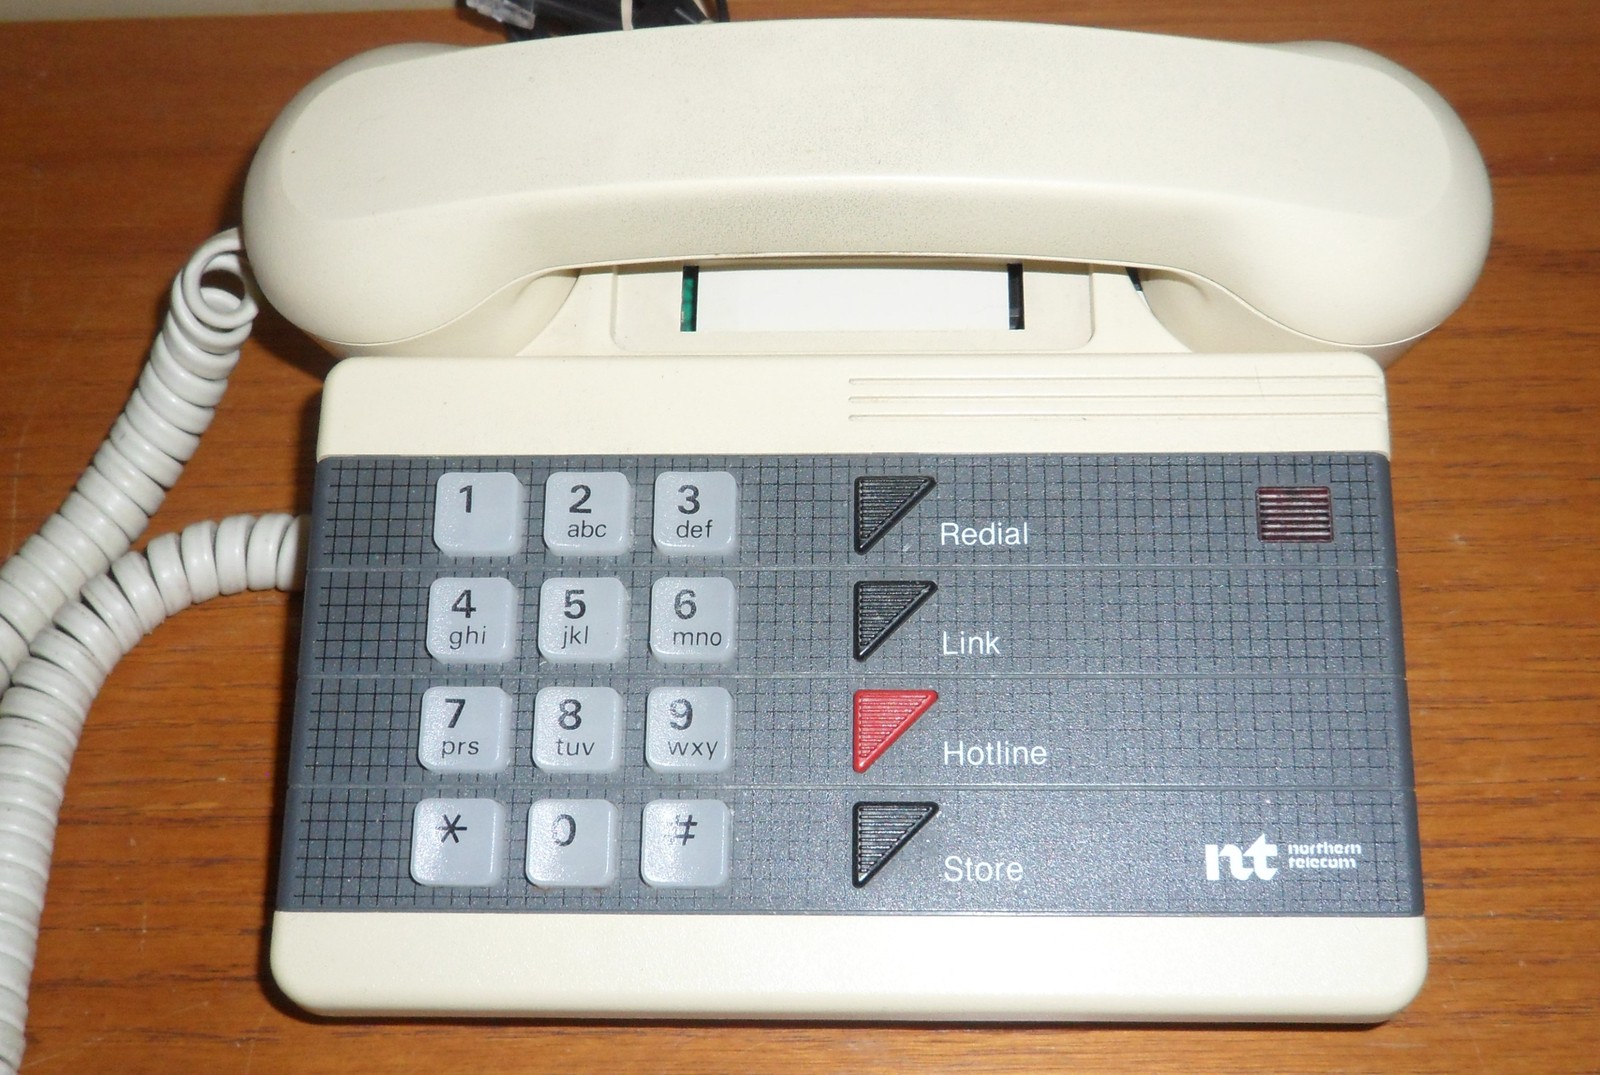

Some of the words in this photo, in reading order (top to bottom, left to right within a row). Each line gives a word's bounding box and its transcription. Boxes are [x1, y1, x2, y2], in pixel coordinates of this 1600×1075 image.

[459, 485, 473, 514] 1
[569, 484, 592, 514] 2
[678, 484, 701, 515] 3
[567, 519, 607, 538] abc
[676, 519, 713, 539] def
[940, 521, 1028, 546] Redial
[451, 589, 477, 619] 4
[564, 589, 586, 620] 5
[674, 589, 697, 620] 6
[449, 625, 486, 650] ghi
[561, 625, 589, 650] jkl
[673, 631, 722, 647] mno
[942, 630, 1001, 656] Link
[445, 698, 466, 729] 7
[558, 699, 582, 731] 8
[670, 699, 693, 731] 9
[441, 739, 479, 758] prs
[556, 739, 595, 756] tuv
[669, 740, 718, 761] wxy
[943, 740, 1048, 766] Hotline
[553, 814, 577, 847] 0
[1287, 841, 1362, 855] northern
[943, 855, 1024, 882] Store
[1287, 855, 1357, 869] telecom
